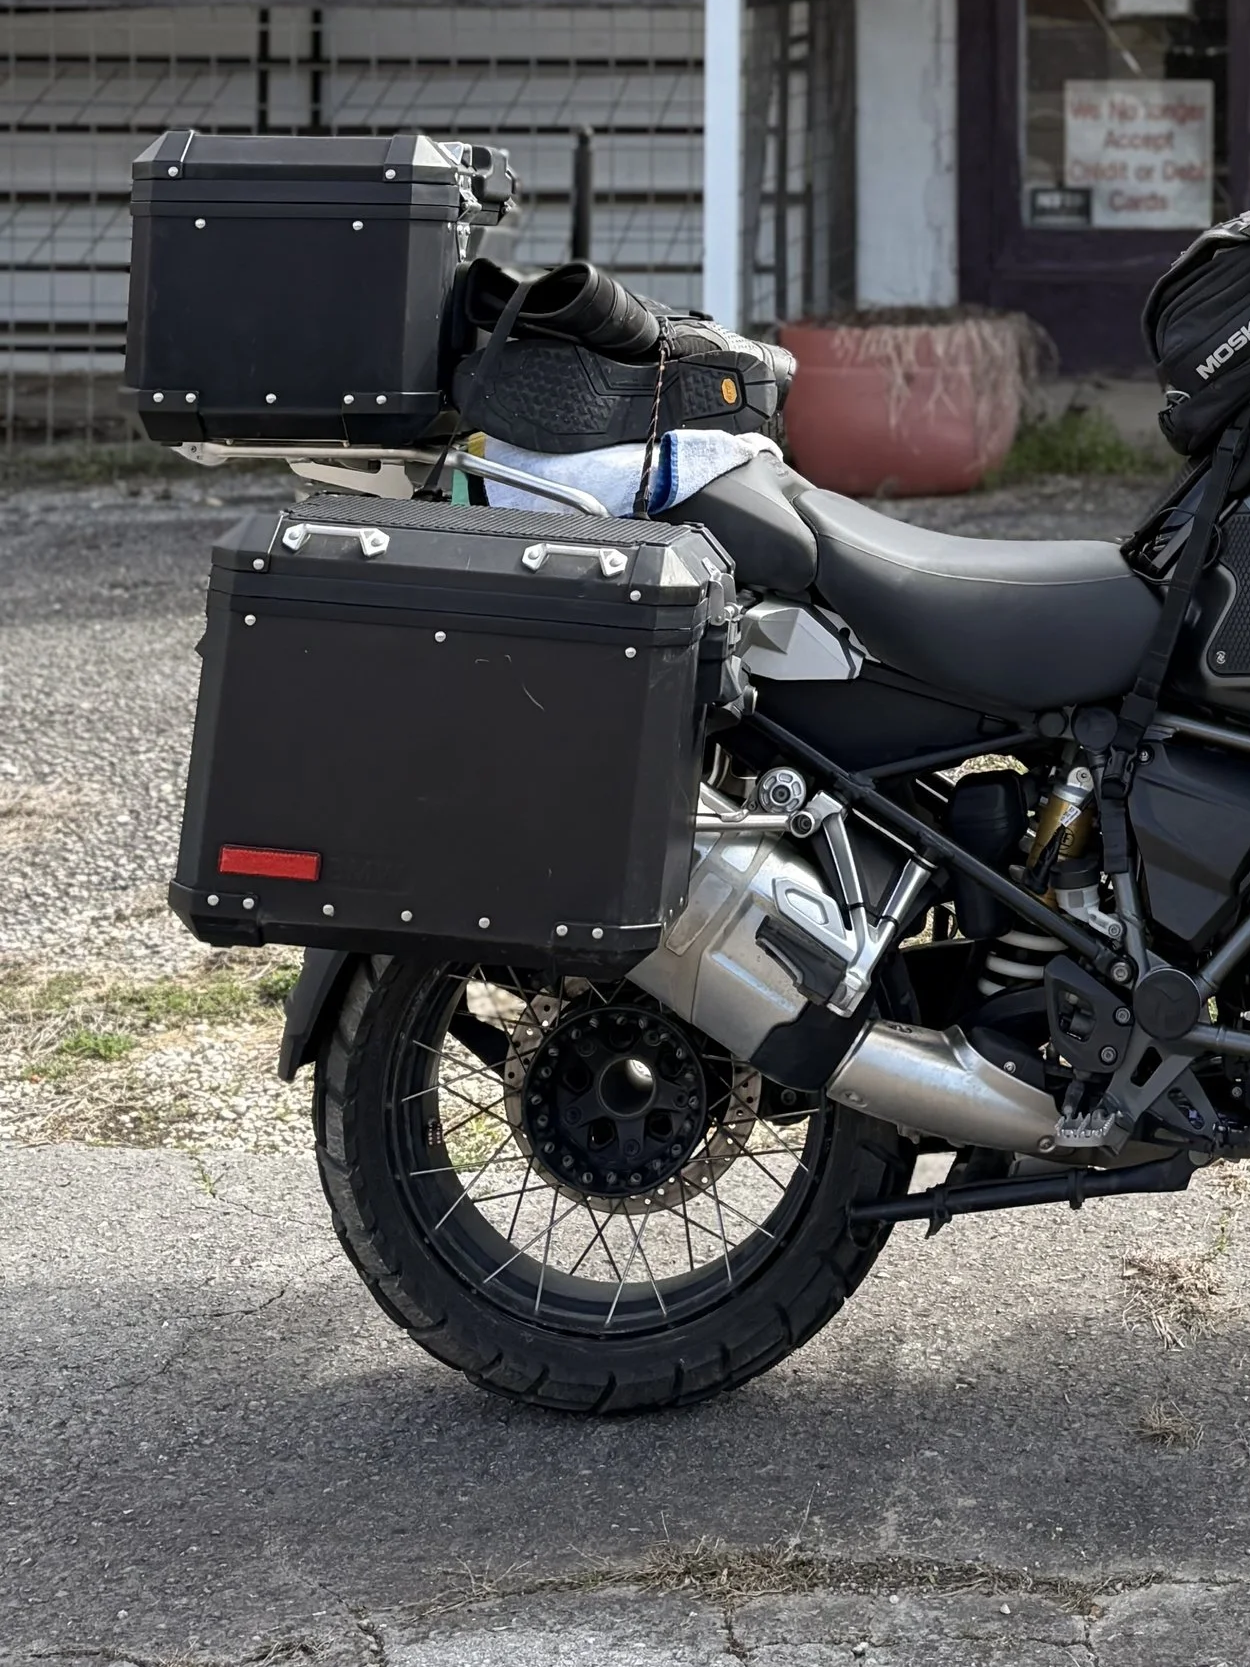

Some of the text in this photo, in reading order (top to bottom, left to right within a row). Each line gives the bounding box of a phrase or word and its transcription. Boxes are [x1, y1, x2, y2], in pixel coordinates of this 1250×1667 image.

[1105, 130, 1175, 153] Accept
[1134, 164, 1155, 181] or
[1108, 189, 1169, 212] Cards
